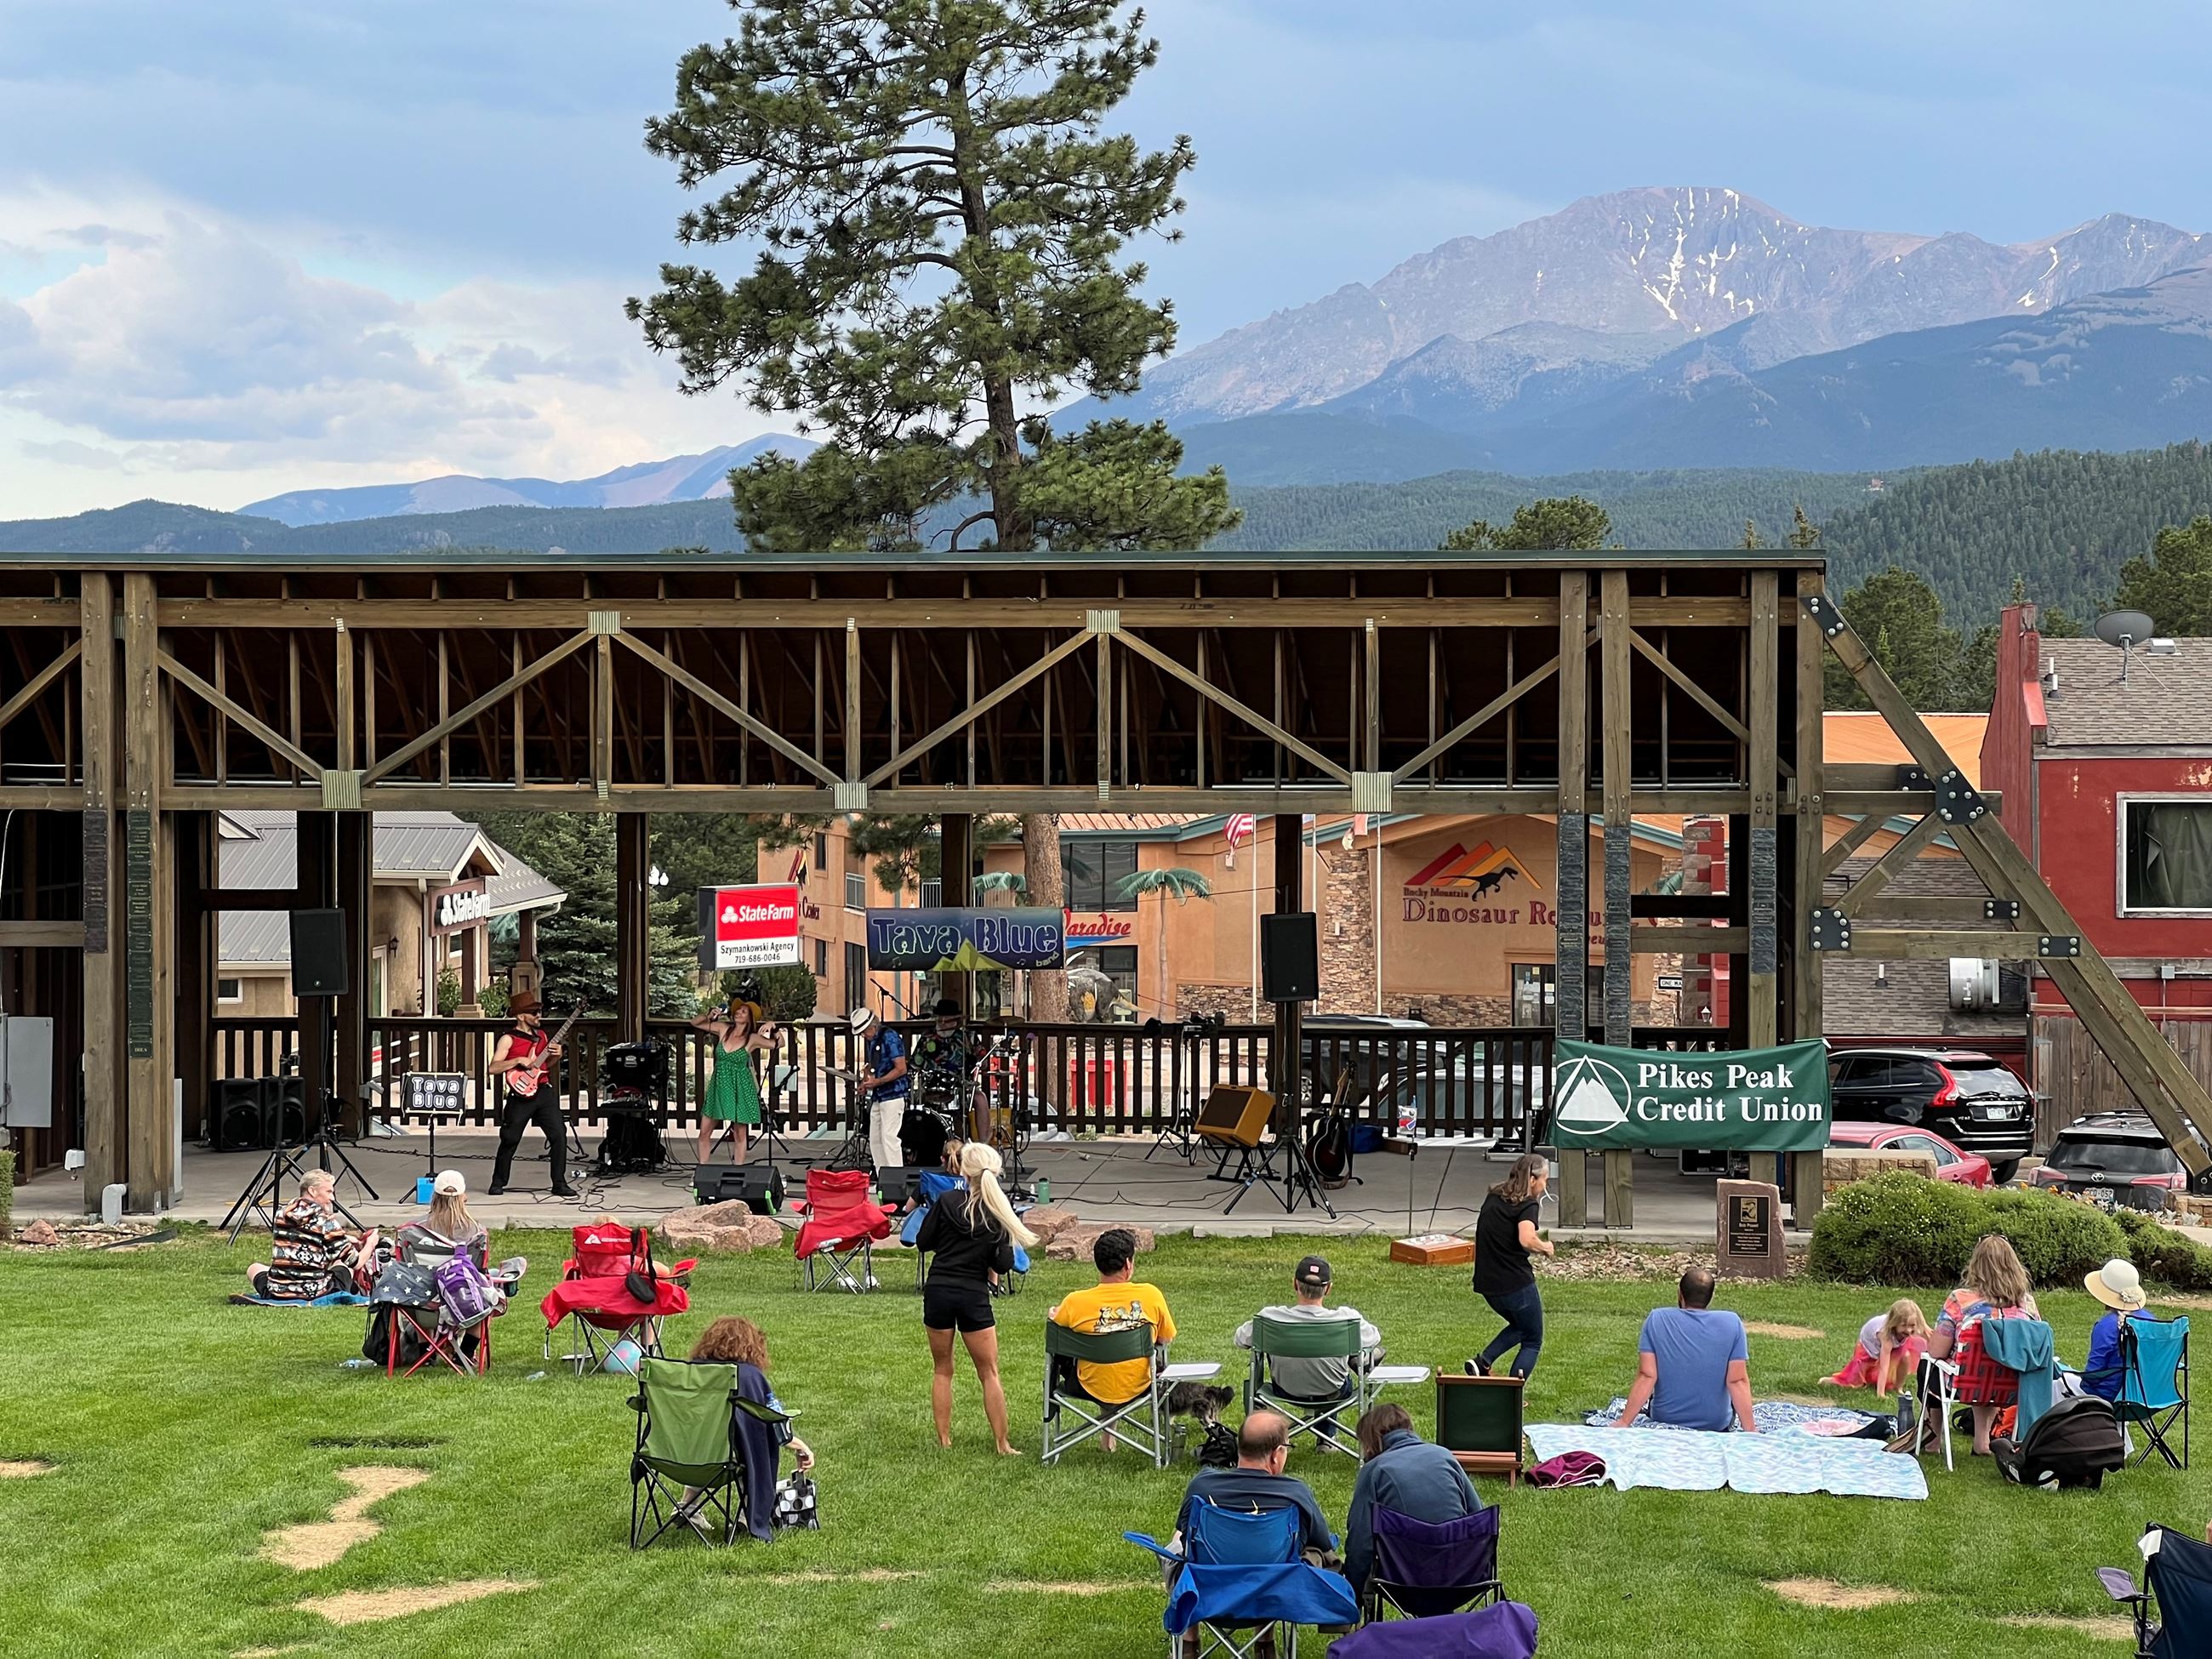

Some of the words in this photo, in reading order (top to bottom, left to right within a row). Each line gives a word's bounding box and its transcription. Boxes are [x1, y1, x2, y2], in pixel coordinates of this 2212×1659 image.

[1403, 887, 1428, 900] Rocky
[1430, 888, 1468, 898] Mountain
[1402, 898, 1520, 924] Dinosaur
[871, 917, 961, 955] Tava
[974, 917, 1058, 954] Blue
[721, 943, 769, 955] Szymankowski
[770, 942, 795, 952] Agency
[734, 953, 781, 963] 719-686-0046
[1035, 951, 1060, 967] band
[1636, 1063, 1713, 1089] Pikes
[1726, 1063, 1794, 1089] Peak
[412, 1077, 459, 1093] Tava
[413, 1092, 457, 1109] Blue
[1636, 1096, 1726, 1122] Credit
[1738, 1097, 1823, 1122] Union
